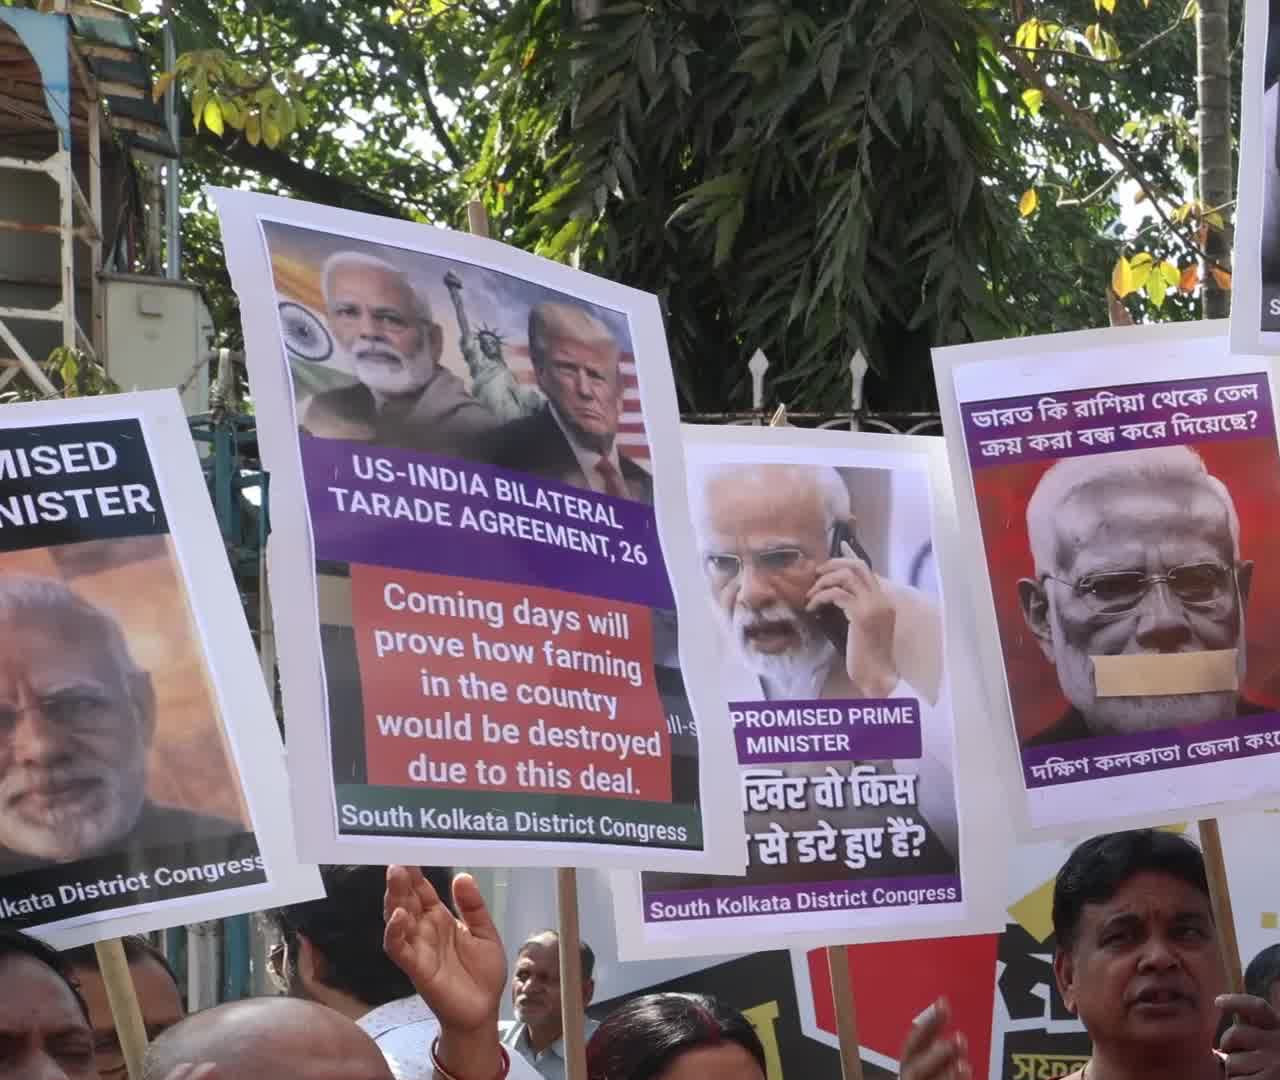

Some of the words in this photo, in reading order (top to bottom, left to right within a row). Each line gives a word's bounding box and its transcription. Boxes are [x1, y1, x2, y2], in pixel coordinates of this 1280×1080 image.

[971, 405, 1034, 430] ভারত
[1038, 396, 1068, 423] কি
[1074, 389, 1146, 419] রাশিয়া
[1151, 388, 1208, 410] থেকে
[1214, 382, 1259, 404] তেল
[1028, 431, 1073, 454] করা
[1078, 424, 1116, 449] বন্ধ
[1120, 420, 1167, 442] করে
[1172, 410, 1258, 435] দিয়েছে?
[352, 454, 489, 498] US-INDIA
[495, 478, 623, 529] BILATERAL
[328, 487, 453, 527] TARADE
[460, 507, 616, 563] AGREEMENT,
[619, 541, 648, 566] 26
[383, 583, 504, 627] Coming
[513, 598, 582, 635] days
[588, 613, 629, 640] will
[375, 629, 465, 658] prove
[472, 634, 534, 664] how
[543, 641, 642, 686] farming
[420, 669, 450, 696] in
[457, 672, 508, 702] the
[516, 681, 618, 720] country
[731, 708, 843, 729] PROMISED
[849, 706, 914, 726] PRIME
[376, 712, 472, 742] would
[482, 715, 521, 745] be
[528, 719, 663, 760] destroyed
[746, 734, 850, 755] MINISTER
[1031, 754, 1090, 782] দক্ষিণ
[1094, 743, 1182, 773] কলকাতা
[1186, 734, 1241, 762] জেলা
[408, 755, 467, 783] due
[474, 760, 506, 785] to
[515, 762, 572, 789] this
[579, 767, 642, 795] deal.
[811, 767, 846, 809] वो
[849, 766, 916, 806] किस
[341, 804, 414, 828] South
[420, 808, 510, 832] Kolkata
[515, 811, 596, 836] District
[600, 815, 689, 842] Congress
[754, 822, 788, 864] से
[793, 820, 838, 863] डरे
[841, 824, 885, 870] हुए
[887, 816, 926, 858] हैं?
[58, 871, 149, 905] District
[154, 856, 265, 886] Congress
[650, 899, 711, 919] South
[716, 895, 792, 916] Kolkata
[797, 890, 868, 911] District
[872, 886, 956, 906] Congress
